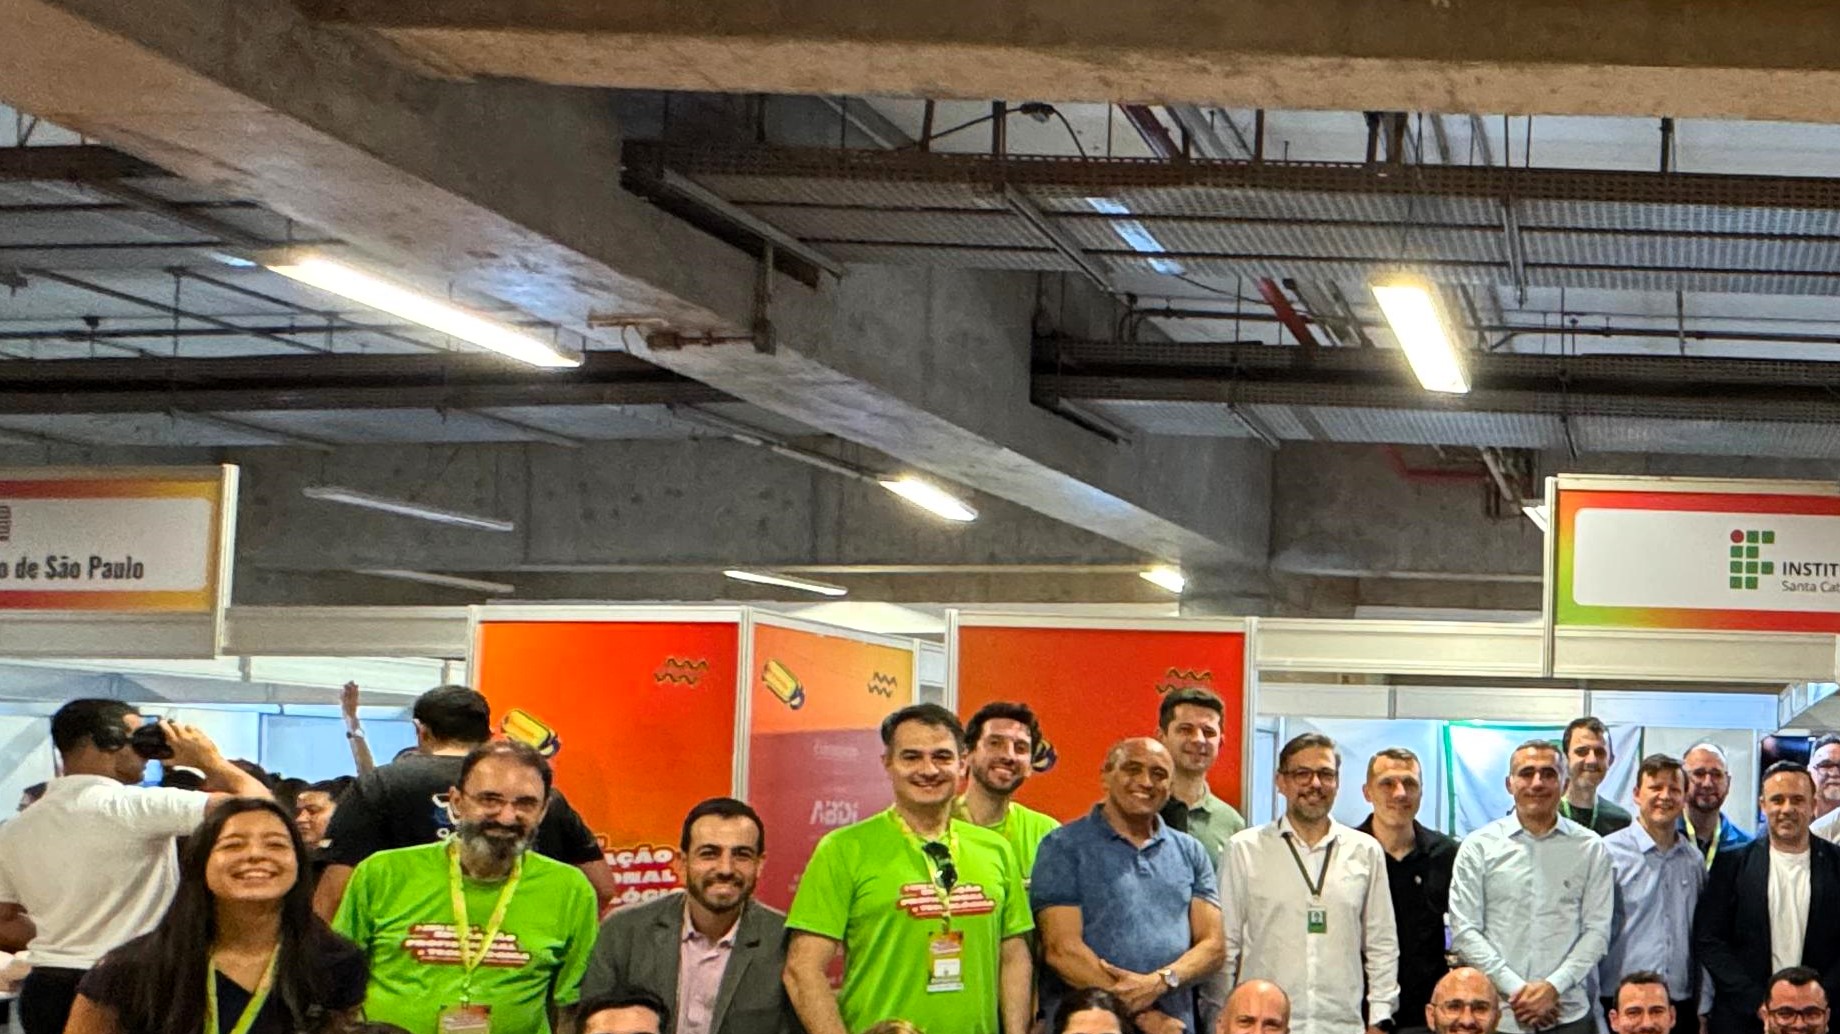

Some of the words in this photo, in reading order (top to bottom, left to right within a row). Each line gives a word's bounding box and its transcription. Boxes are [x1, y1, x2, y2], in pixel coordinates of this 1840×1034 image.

[15, 557, 38, 579] de
[45, 555, 81, 580] São
[88, 555, 144, 580] Paulo
[1781, 580, 1816, 592] Santa
